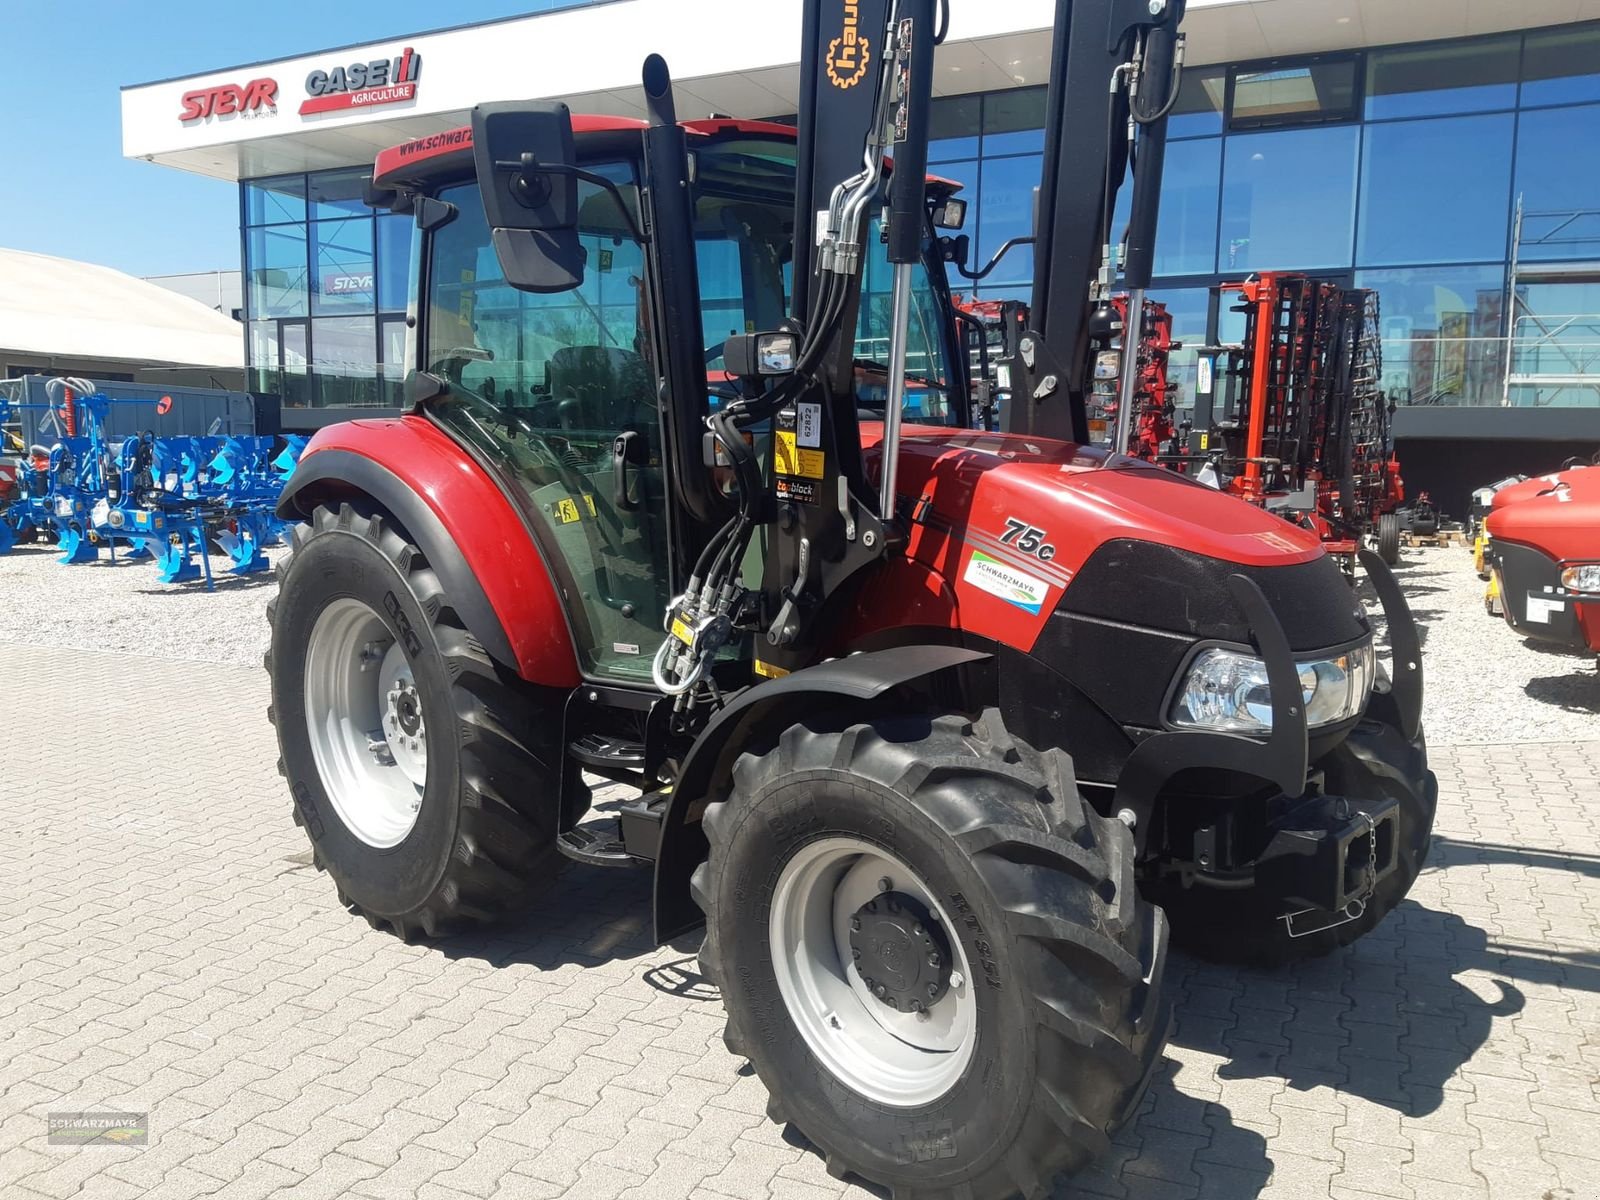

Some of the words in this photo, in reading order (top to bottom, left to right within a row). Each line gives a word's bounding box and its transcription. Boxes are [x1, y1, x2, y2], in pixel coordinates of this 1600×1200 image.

[304, 57, 389, 97] CASE
[179, 77, 279, 121] STEYR
[351, 85, 411, 106] AGRICULTURE
[804, 407, 812, 438] 62822
[976, 562, 1035, 594] SCHWARZMAYR
